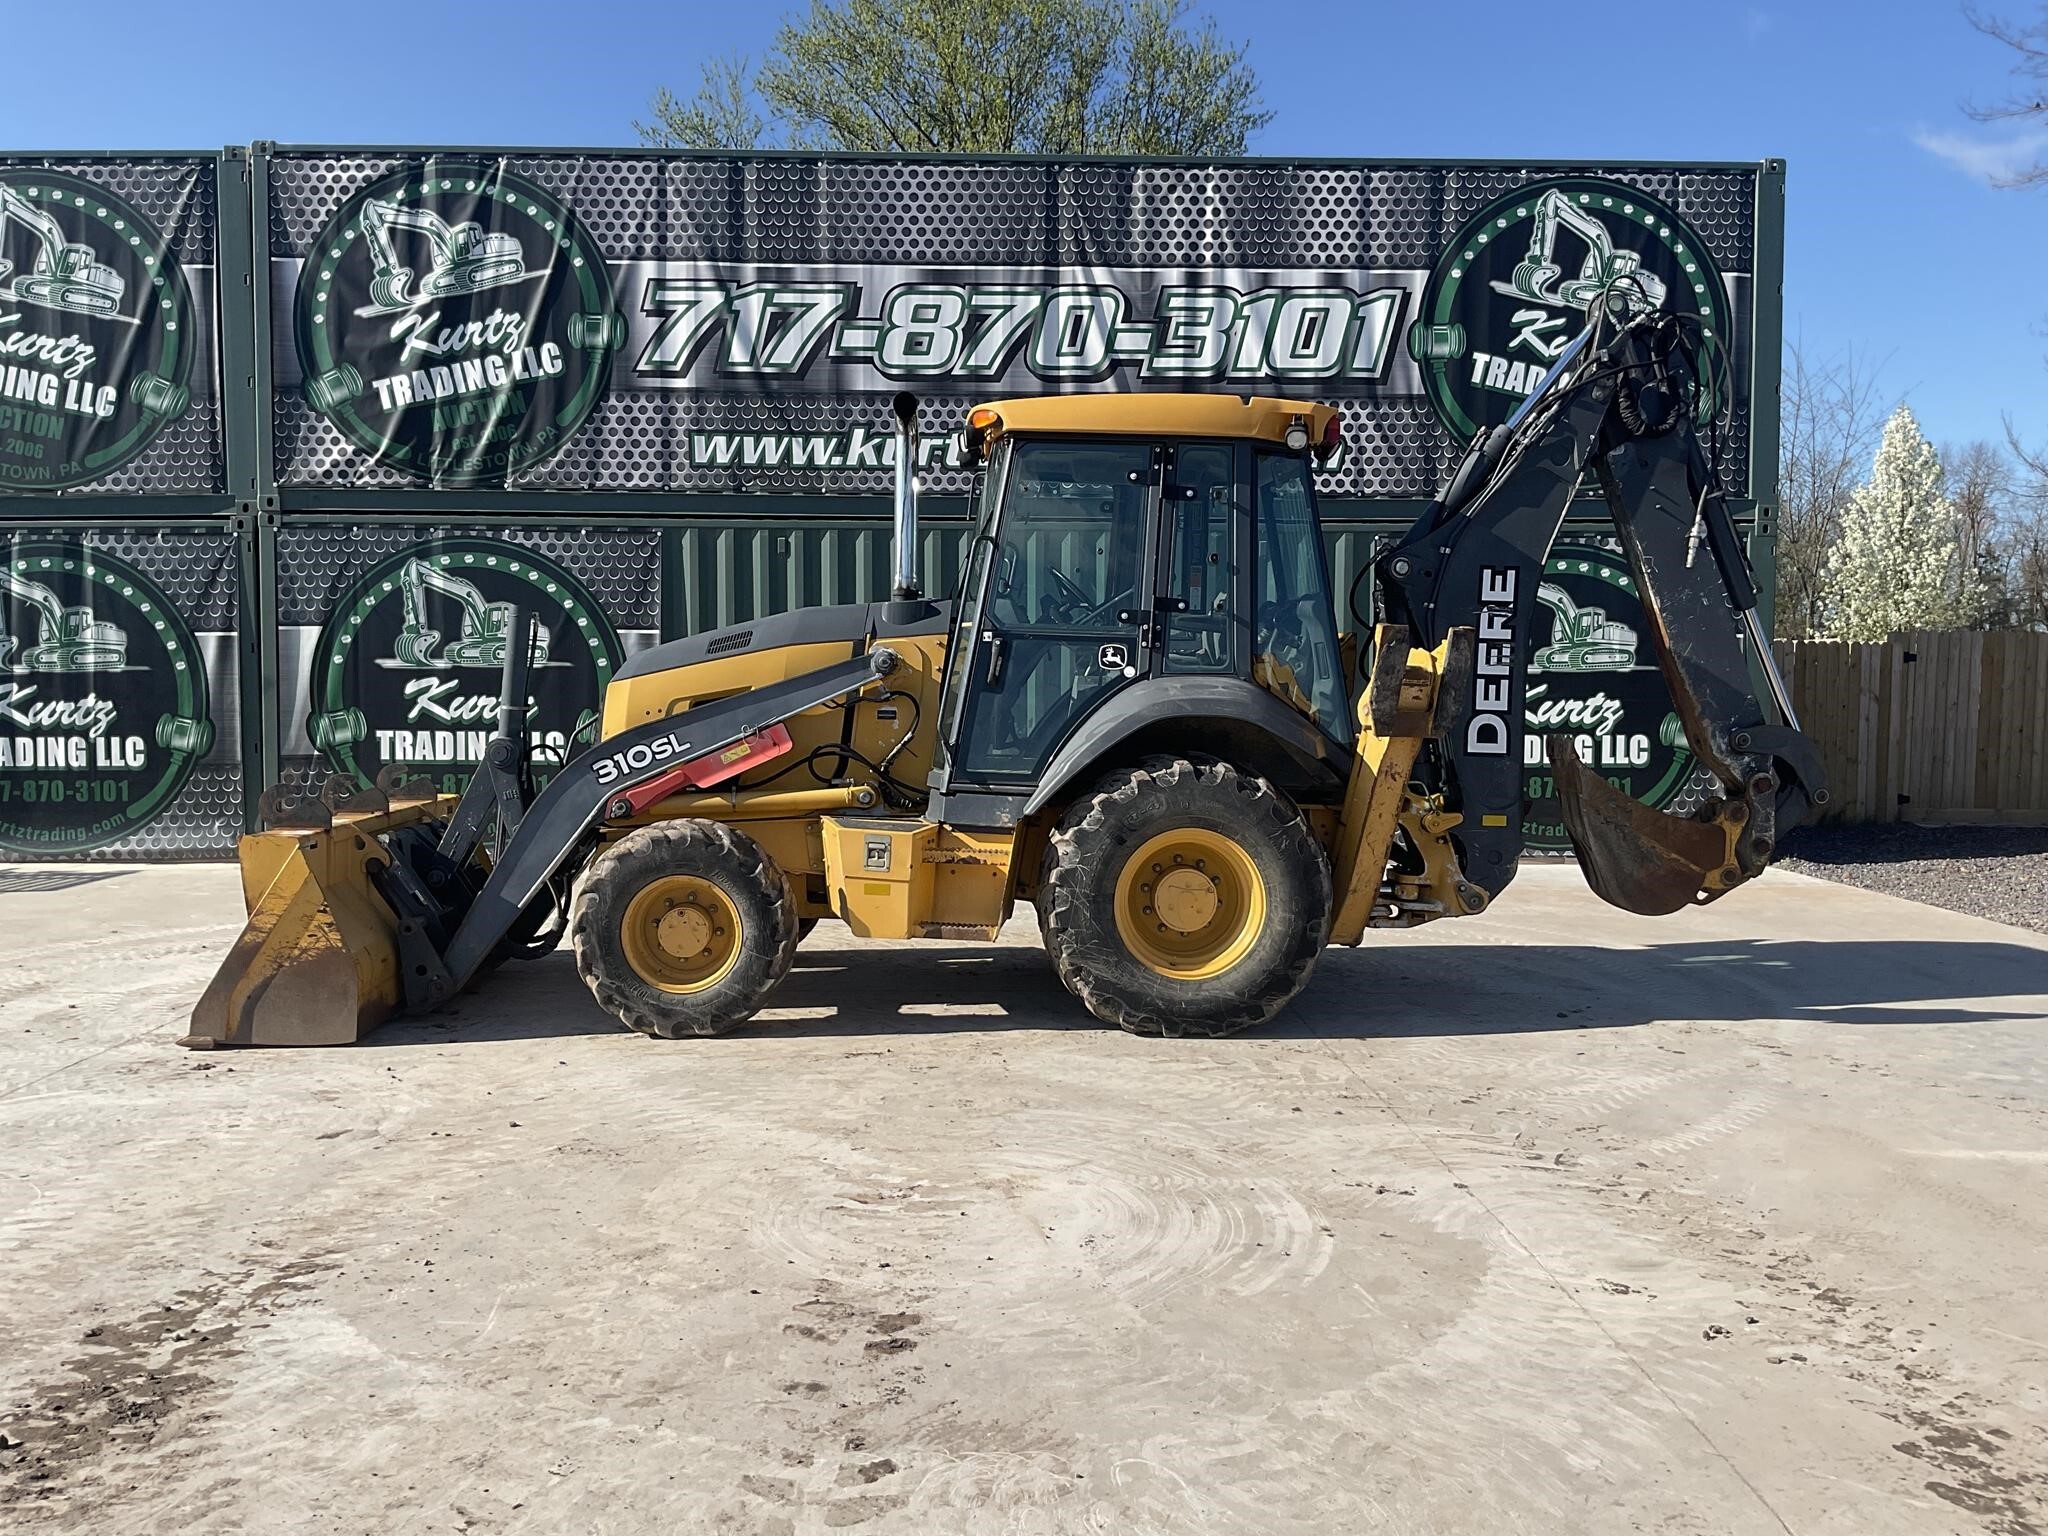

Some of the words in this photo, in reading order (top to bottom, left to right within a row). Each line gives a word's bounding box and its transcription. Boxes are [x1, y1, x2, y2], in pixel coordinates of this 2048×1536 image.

[390, 308, 526, 361] Kurtz
[635, 279, 1408, 383] 717-870-3101
[372, 355, 507, 410] TRADING
[511, 342, 563, 380] LLC
[65, 379, 117, 417] LLC
[431, 390, 528, 433] AUCTION
[7, 438, 45, 459] 2006
[536, 425, 558, 445] PA
[60, 460, 82, 477] PA
[1467, 568, 1516, 753] DEERE
[96, 736, 145, 767] LLC
[592, 733, 691, 785] 310SL
[1602, 735, 1648, 764] LLC
